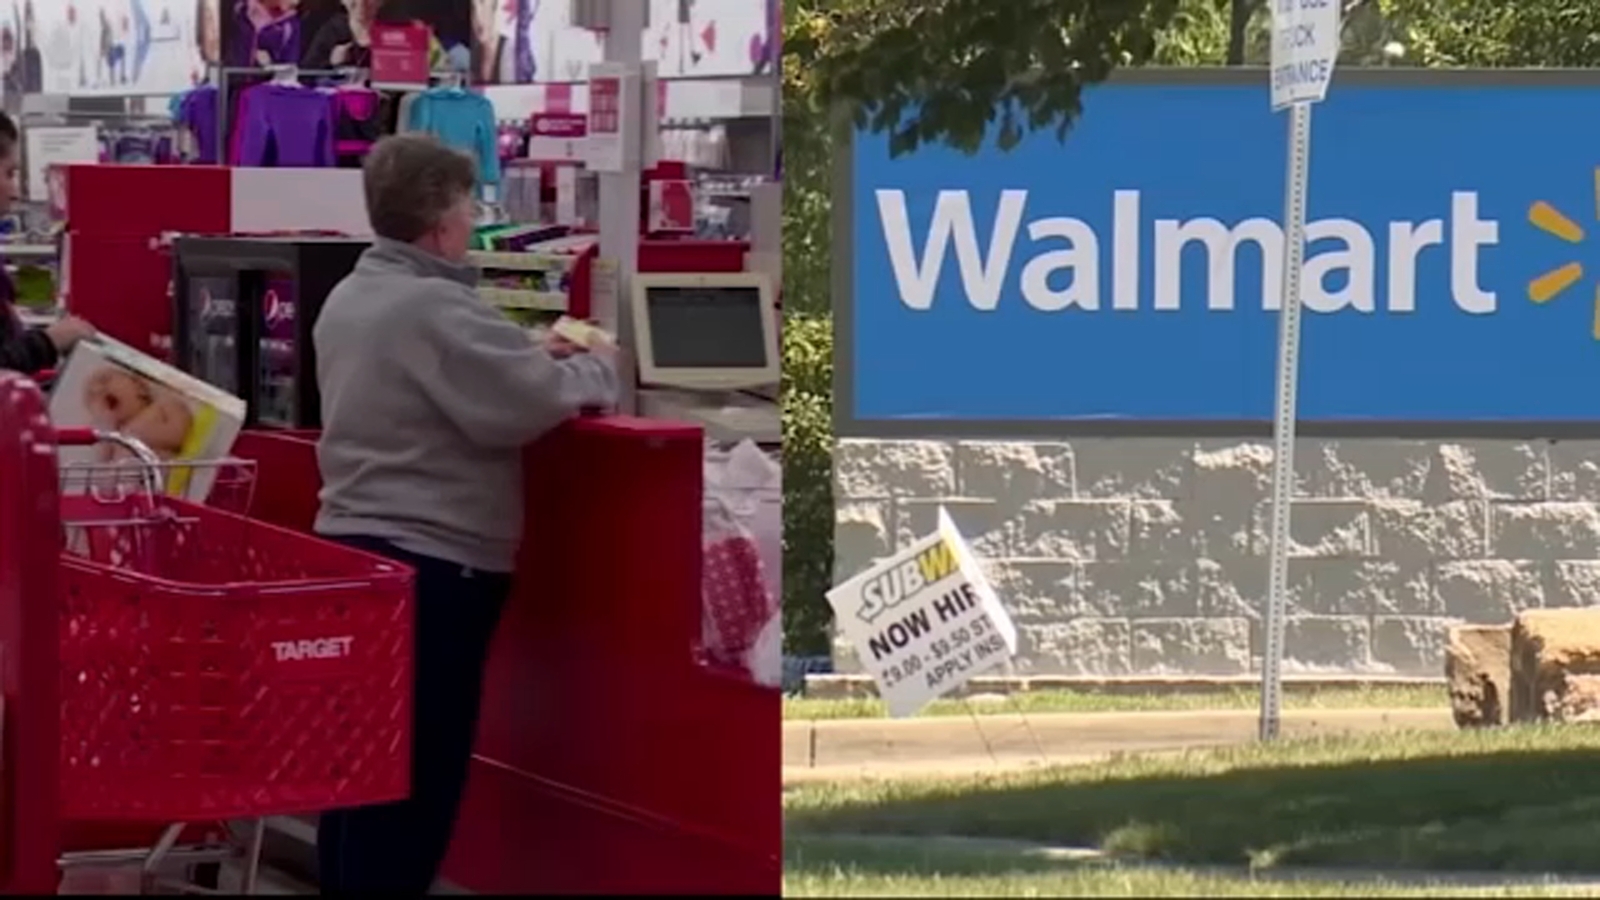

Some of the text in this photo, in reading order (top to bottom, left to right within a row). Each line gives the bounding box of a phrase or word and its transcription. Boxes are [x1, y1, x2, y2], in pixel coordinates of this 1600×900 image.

[875, 189, 1498, 313] Walmart
[270, 635, 355, 662] TARGET
[869, 608, 931, 660] NOW
[930, 627, 970, 659] $9.50
[926, 650, 973, 688] APPLY
